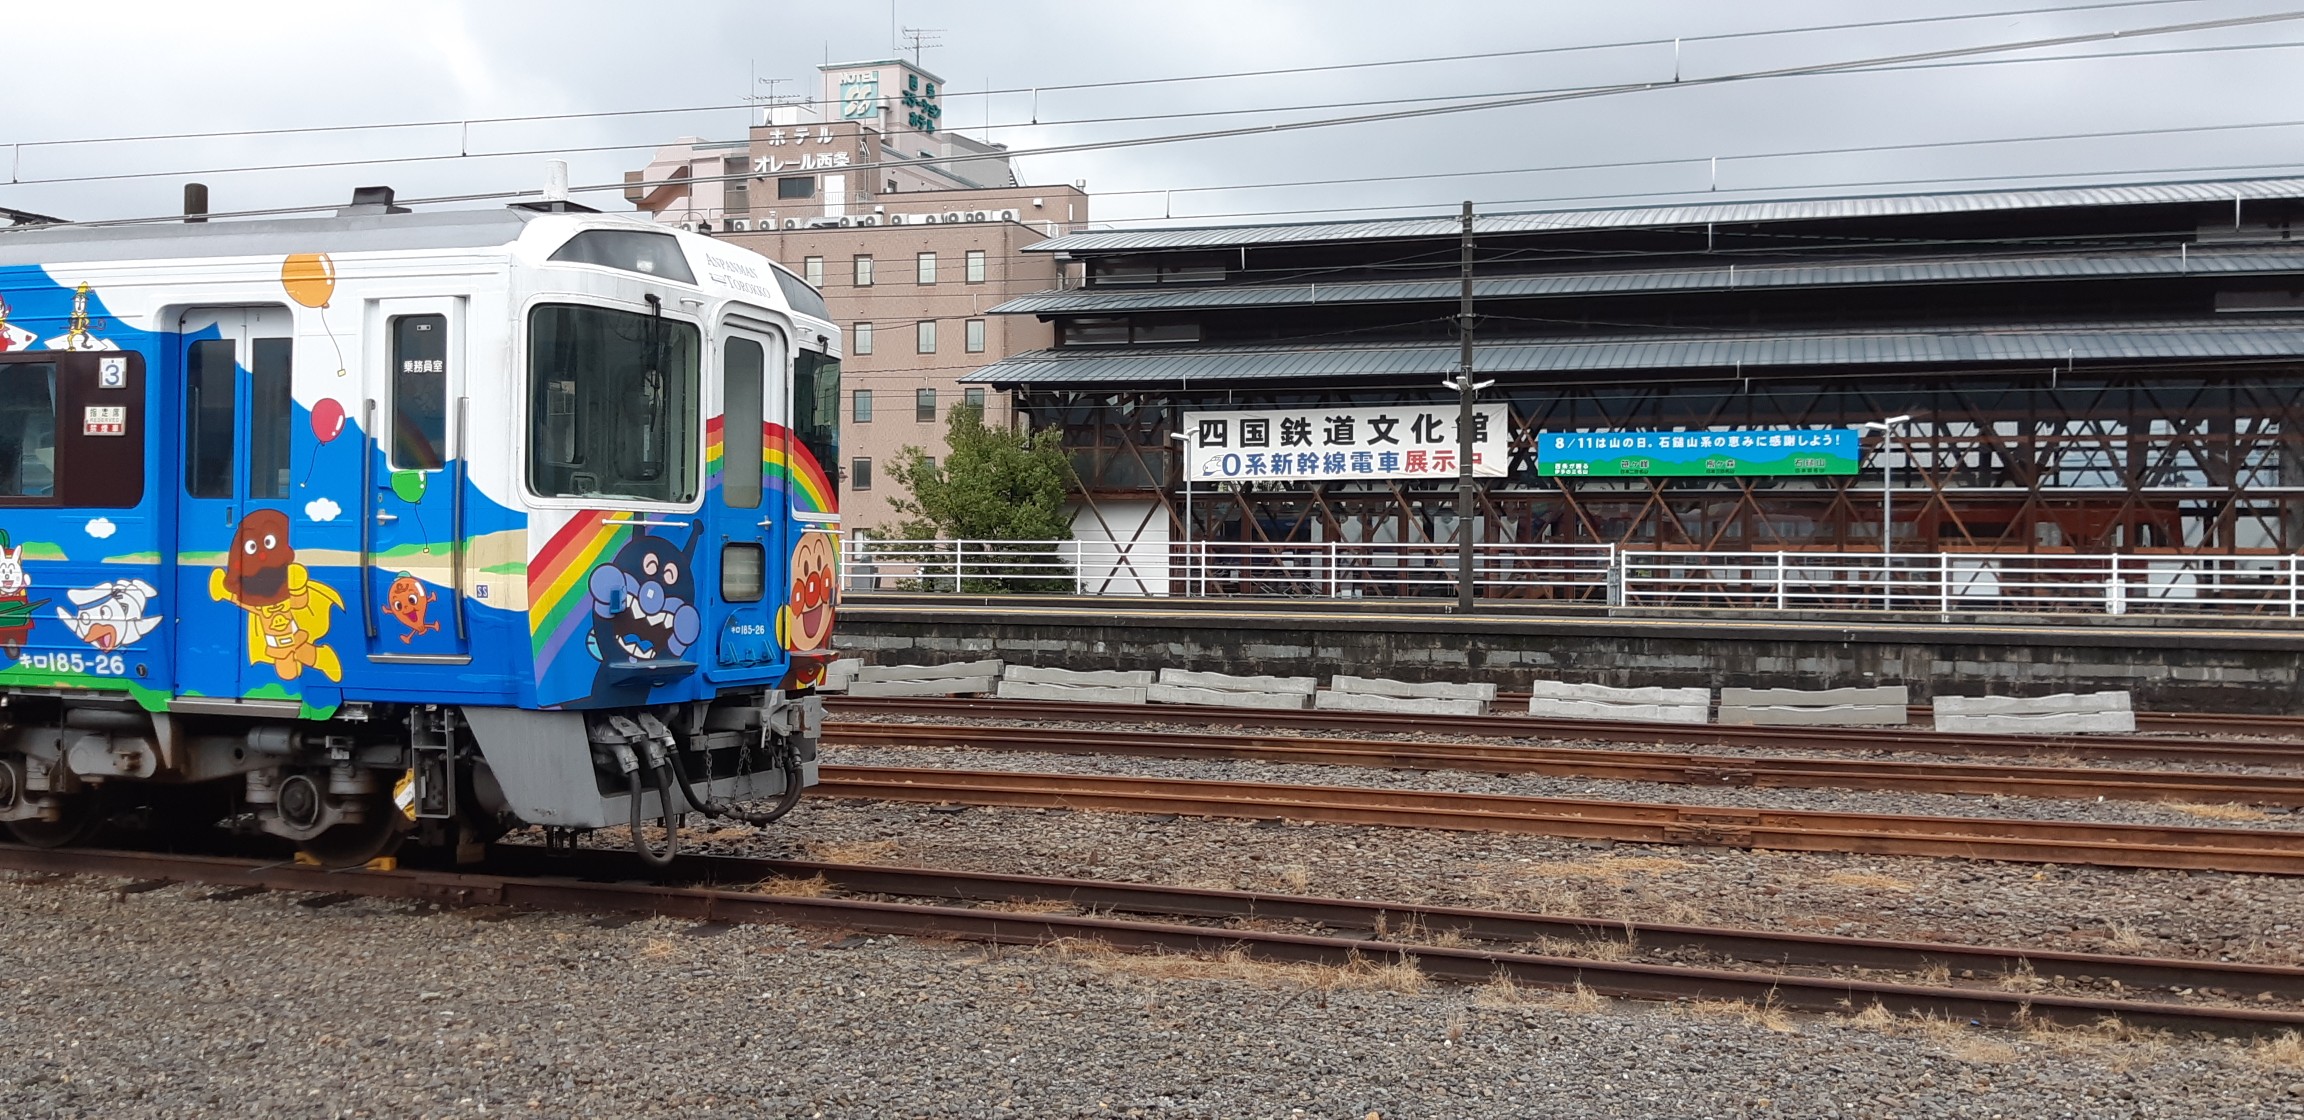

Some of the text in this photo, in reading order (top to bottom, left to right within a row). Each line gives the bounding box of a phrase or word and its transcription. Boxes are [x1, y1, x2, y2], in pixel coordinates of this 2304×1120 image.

[840, 71, 878, 85] HOTEL
[768, 126, 835, 147] ホテル
[754, 151, 850, 173] オレール西条
[705, 252, 759, 280] ANPANMAN
[723, 274, 771, 299] TOROKKO
[104, 364, 120, 386] 3
[403, 359, 443, 374] 乗務員室
[1199, 412, 1490, 448] 四国鉄道文化館
[477, 586, 488, 597] SS
[20, 652, 126, 675] キロ185-26
